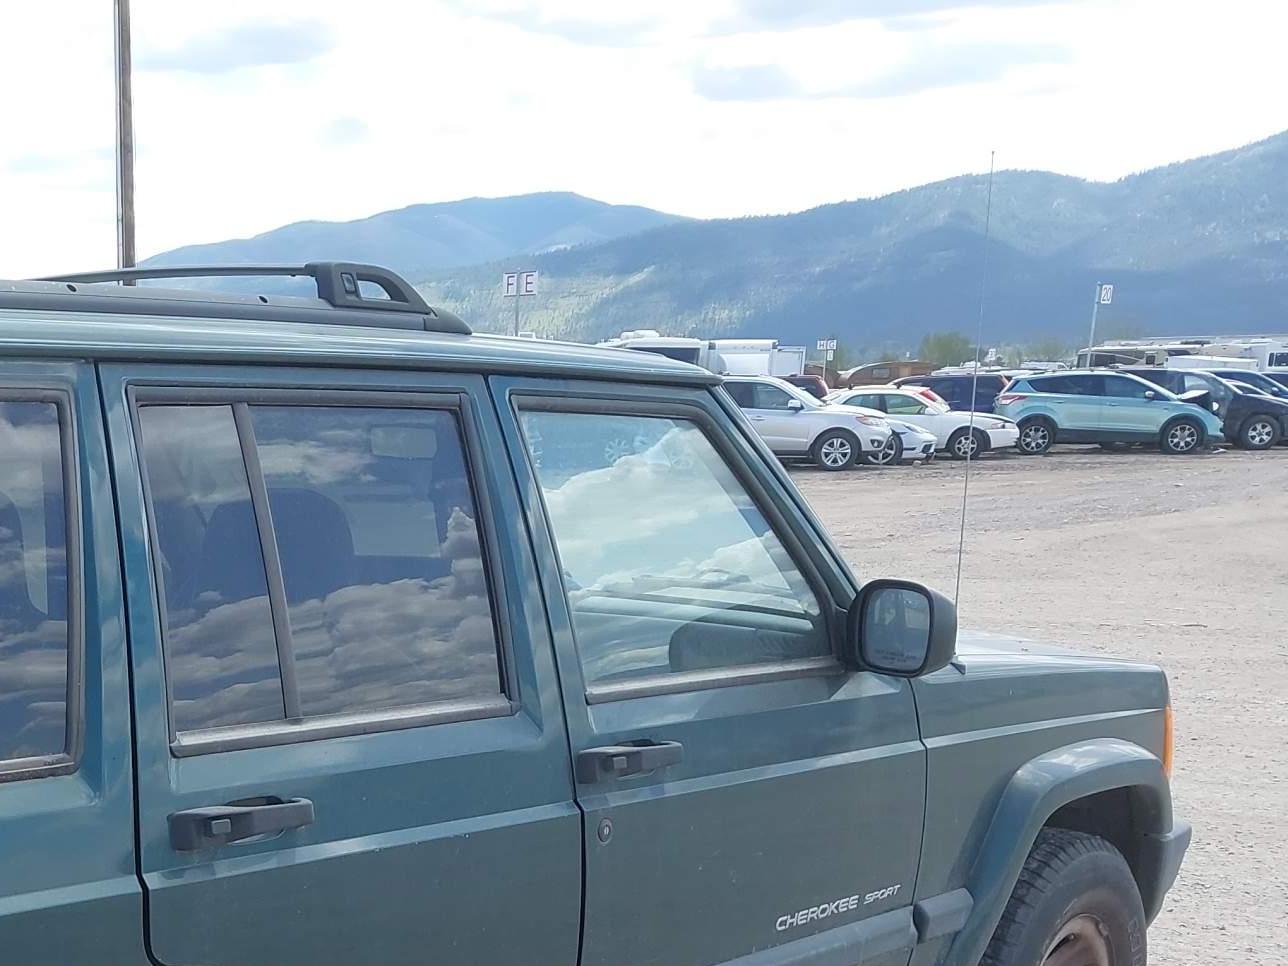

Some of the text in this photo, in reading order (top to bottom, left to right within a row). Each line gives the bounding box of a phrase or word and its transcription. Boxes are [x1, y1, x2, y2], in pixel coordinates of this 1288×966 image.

[506, 275, 516, 294] F
[525, 273, 535, 293] E
[1101, 287, 1112, 302] 20
[775, 884, 902, 931] CHEROKEE SPORT
